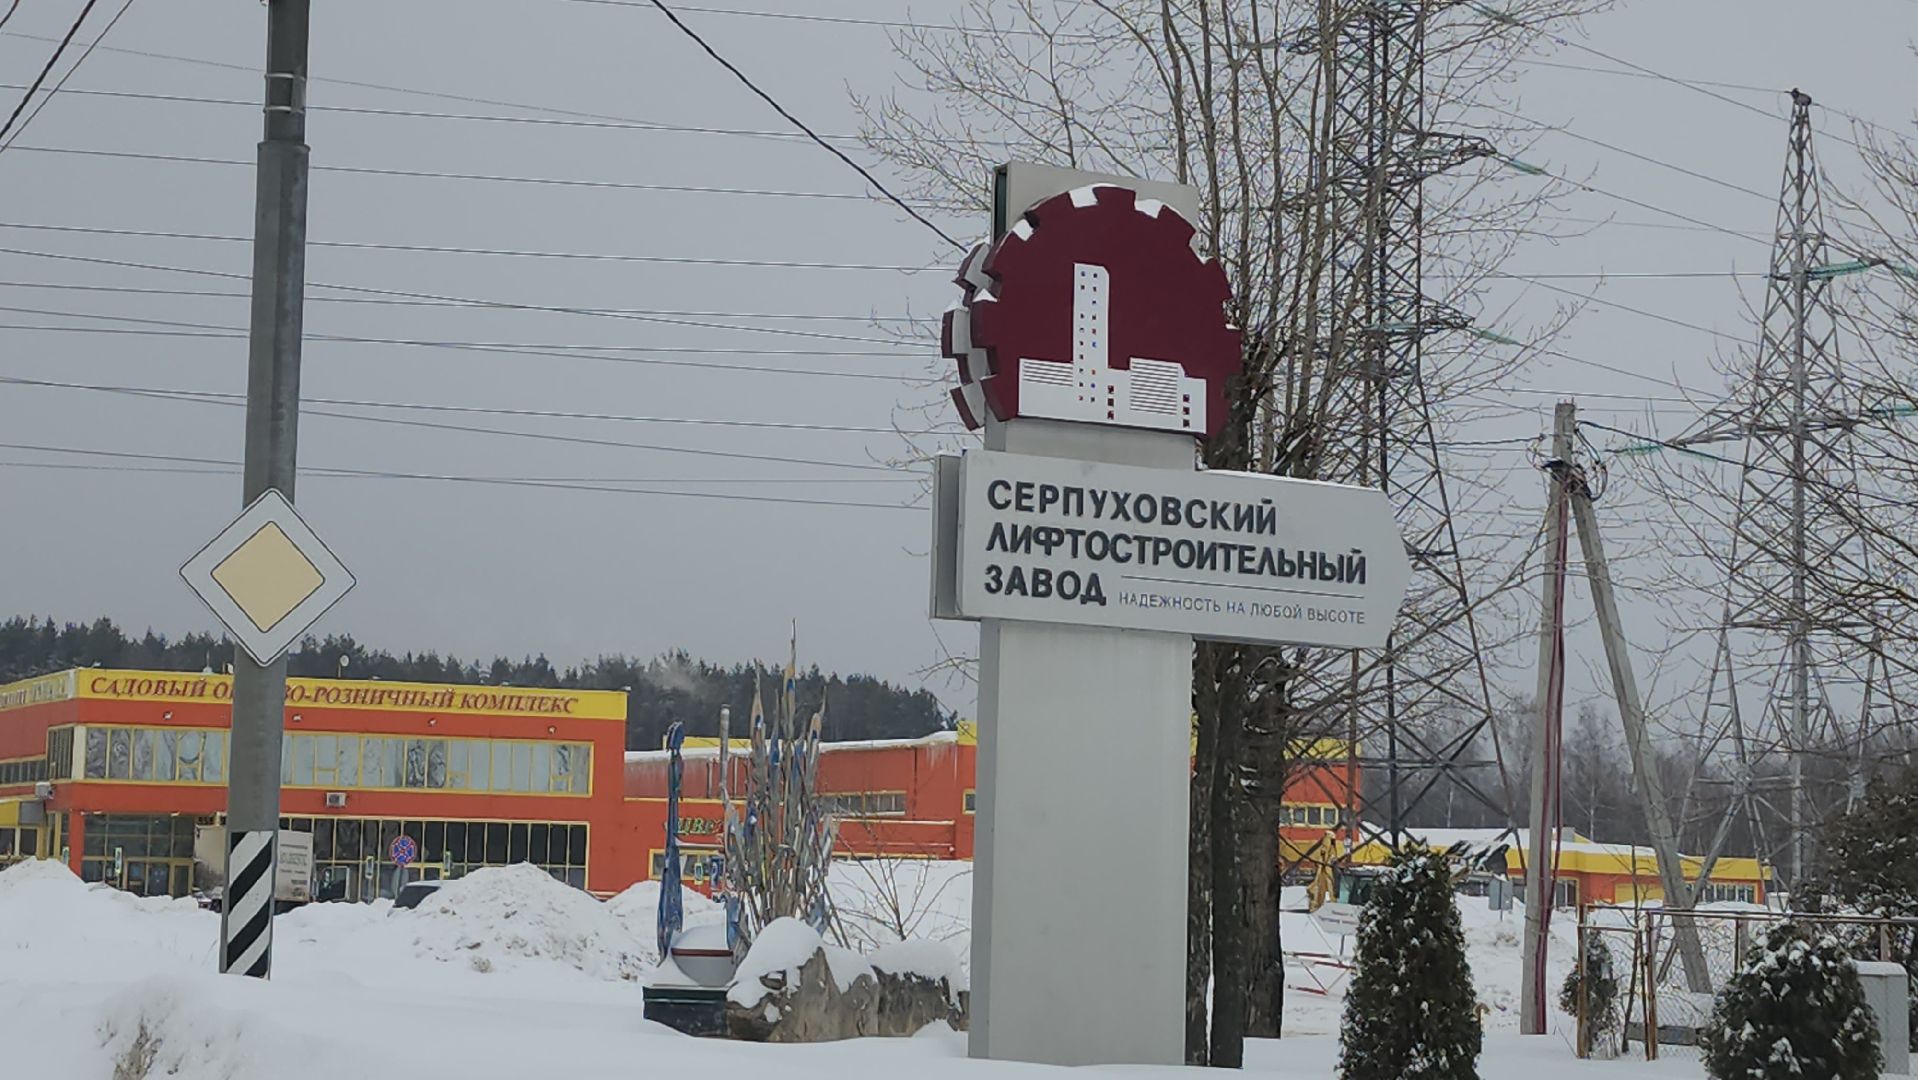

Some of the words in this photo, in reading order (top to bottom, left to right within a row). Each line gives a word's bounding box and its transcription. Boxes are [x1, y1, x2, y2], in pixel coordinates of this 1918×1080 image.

[987, 479, 1277, 535] СЕРПУХОВСКИЙ
[986, 522, 1367, 585] ЛИФТОСТРОИТЕЛЬНЫЙ
[984, 565, 1107, 606] ЗАВОД
[1119, 591, 1222, 613] НАДЕЖНОСТЬ
[1227, 602, 1245, 615] НА
[1250, 602, 1302, 620] ЛЮБОЙ
[1307, 608, 1365, 625] ВЫСОТЕ
[91, 676, 207, 698] САДОВЫЙ
[213, 680, 455, 708] ОО-РОЗНИЧНЫЙ
[459, 690, 579, 714] КОМПЛЕКС
